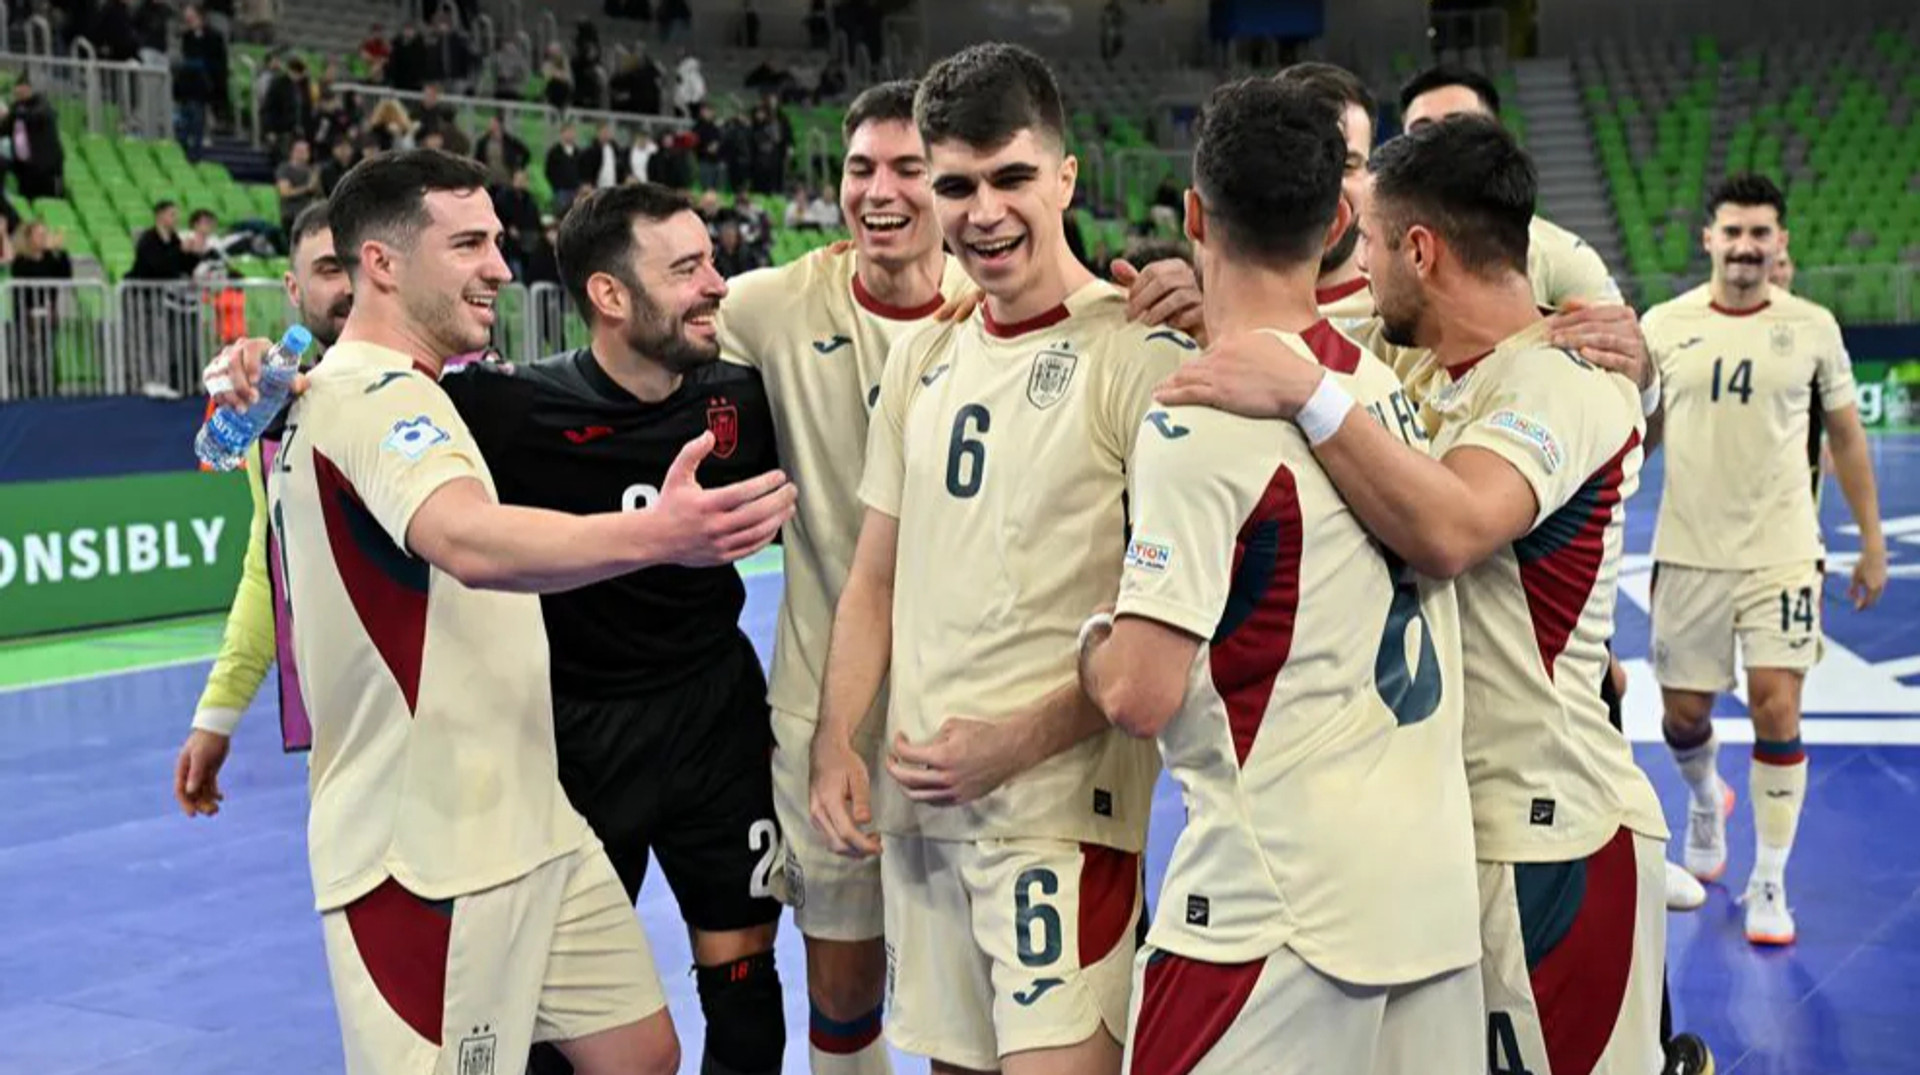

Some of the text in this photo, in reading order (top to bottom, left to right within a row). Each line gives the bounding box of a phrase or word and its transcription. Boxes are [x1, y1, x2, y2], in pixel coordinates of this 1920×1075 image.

[1711, 357, 1753, 404] 14
[946, 403, 991, 499] 6
[0, 516, 226, 589] ONSIBLY
[1781, 586, 1814, 632] 14
[1014, 868, 1063, 967] 6
